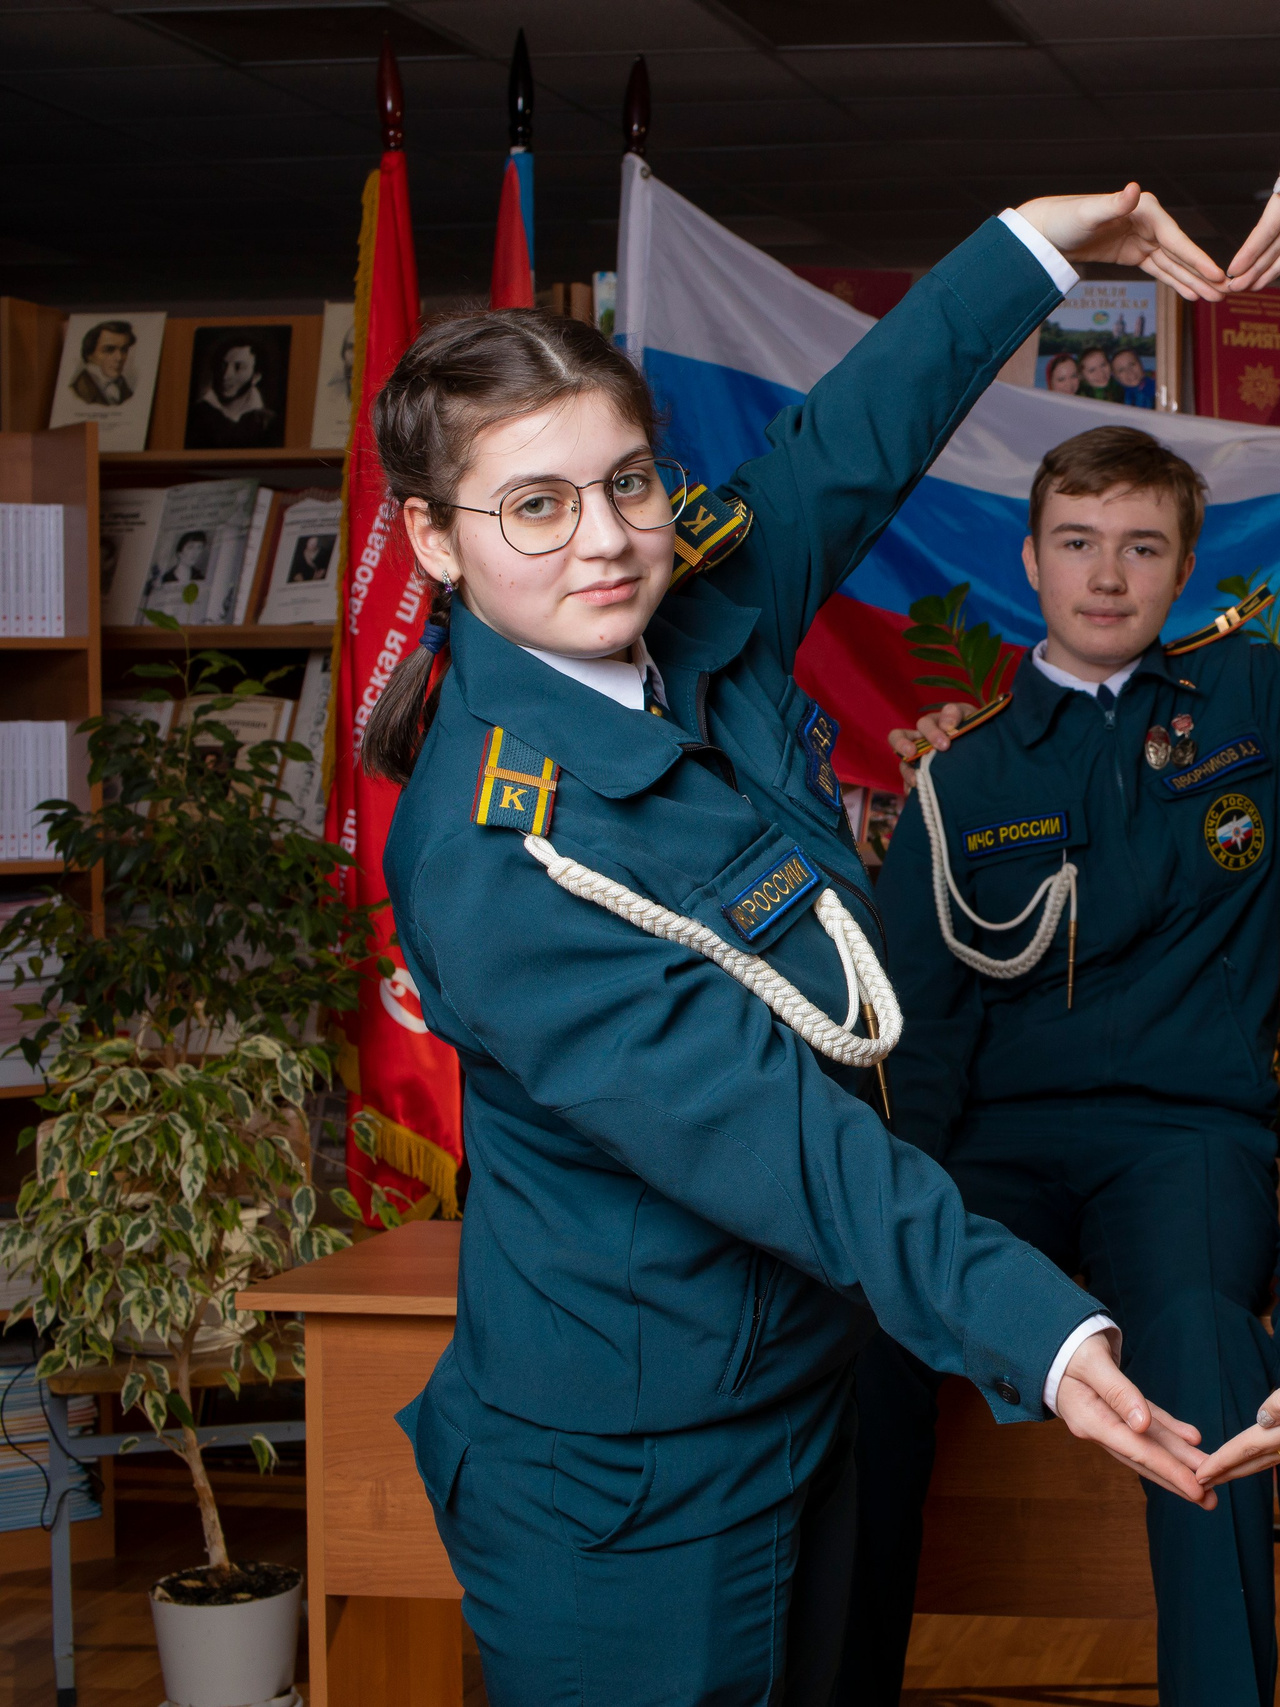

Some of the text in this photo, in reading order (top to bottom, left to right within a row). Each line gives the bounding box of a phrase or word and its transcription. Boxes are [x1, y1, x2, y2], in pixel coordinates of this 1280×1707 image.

[681, 505, 717, 536] К
[1171, 747, 1240, 790] ДВОРНИКОВ
[499, 785, 528, 812] К
[1206, 797, 1261, 837] МЧС РОССИИ
[967, 817, 1061, 852] МЧС РОССИИ
[741, 858, 809, 921] РОССИИ
